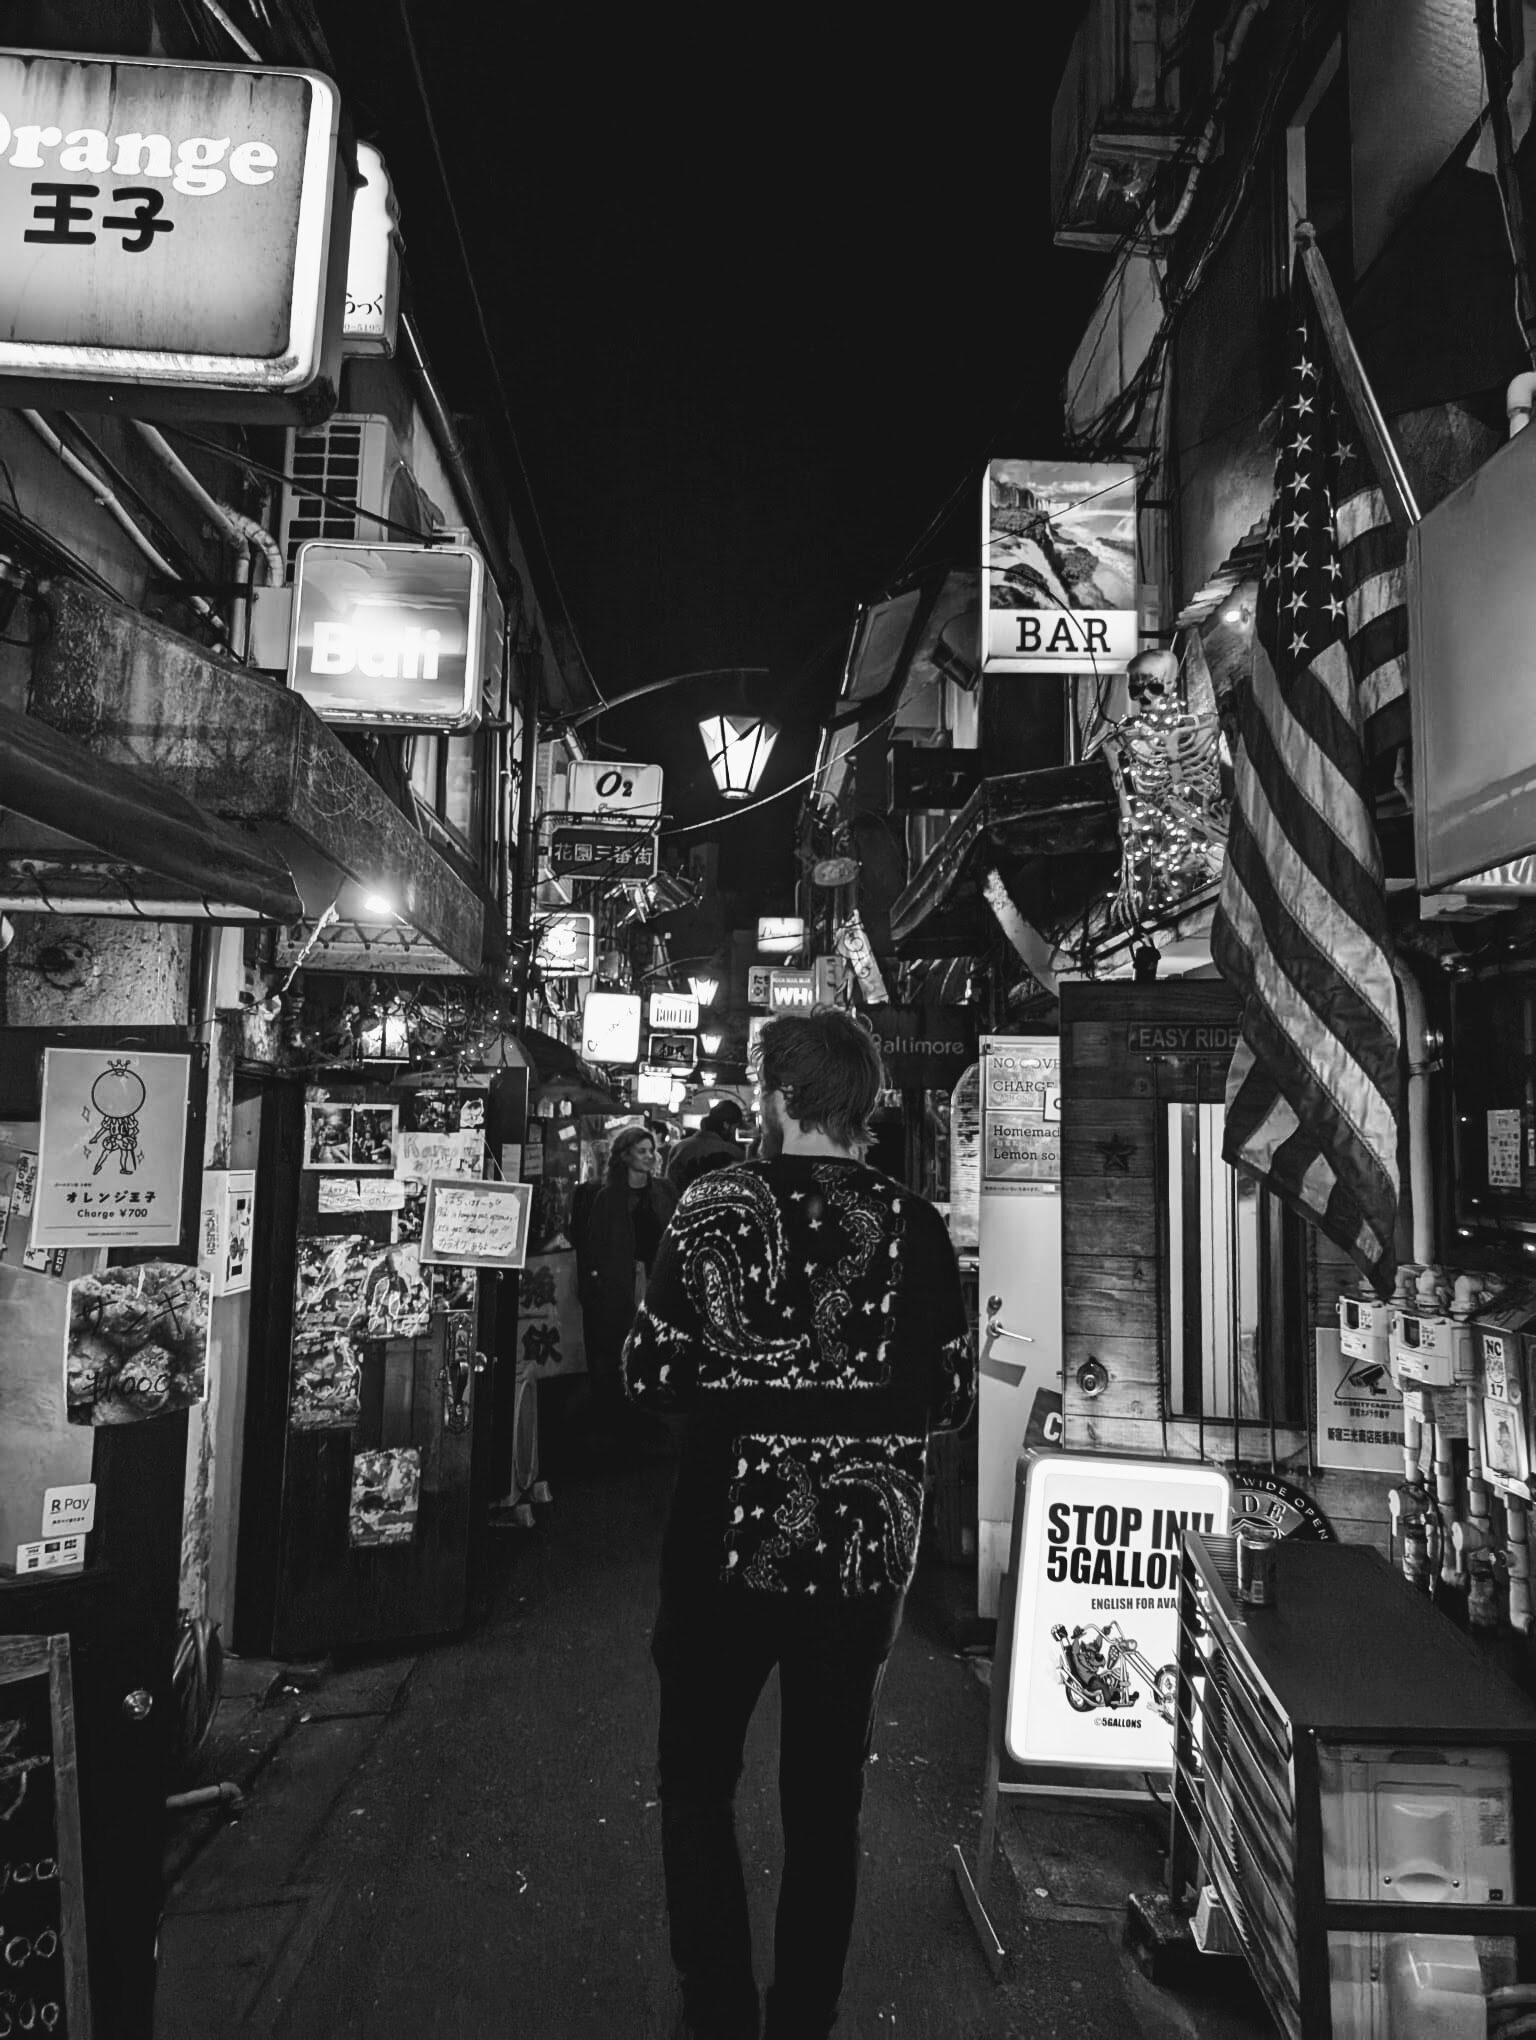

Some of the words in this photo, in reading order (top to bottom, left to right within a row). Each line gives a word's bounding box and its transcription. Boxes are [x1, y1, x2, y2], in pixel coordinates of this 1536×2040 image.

[24, 182, 175, 253] 王子
[1015, 616, 1111, 653] BAR
[310, 621, 441, 680] Bali
[596, 770, 634, 797] O2
[554, 842, 653, 865] 花園三番街
[1139, 1028, 1190, 1048] EASY
[993, 1057, 1015, 1069] NO
[993, 1148, 1037, 1160] Lemon
[66, 1190, 156, 1203] オレンジ王子
[77, 1209, 115, 1219] Charge
[119, 1208, 148, 1218] ¥700
[1485, 1339, 1502, 1357] NC
[1490, 1383, 1504, 1398] 17
[64, 1498, 90, 1511] Pay
[1242, 1476, 1288, 1497] WIDE
[1294, 1497, 1329, 1540] OPEN
[1047, 1502, 1143, 1548] STOP
[1090, 1597, 1134, 1610] ENGLISH
[1135, 1598, 1154, 1610] FOR
